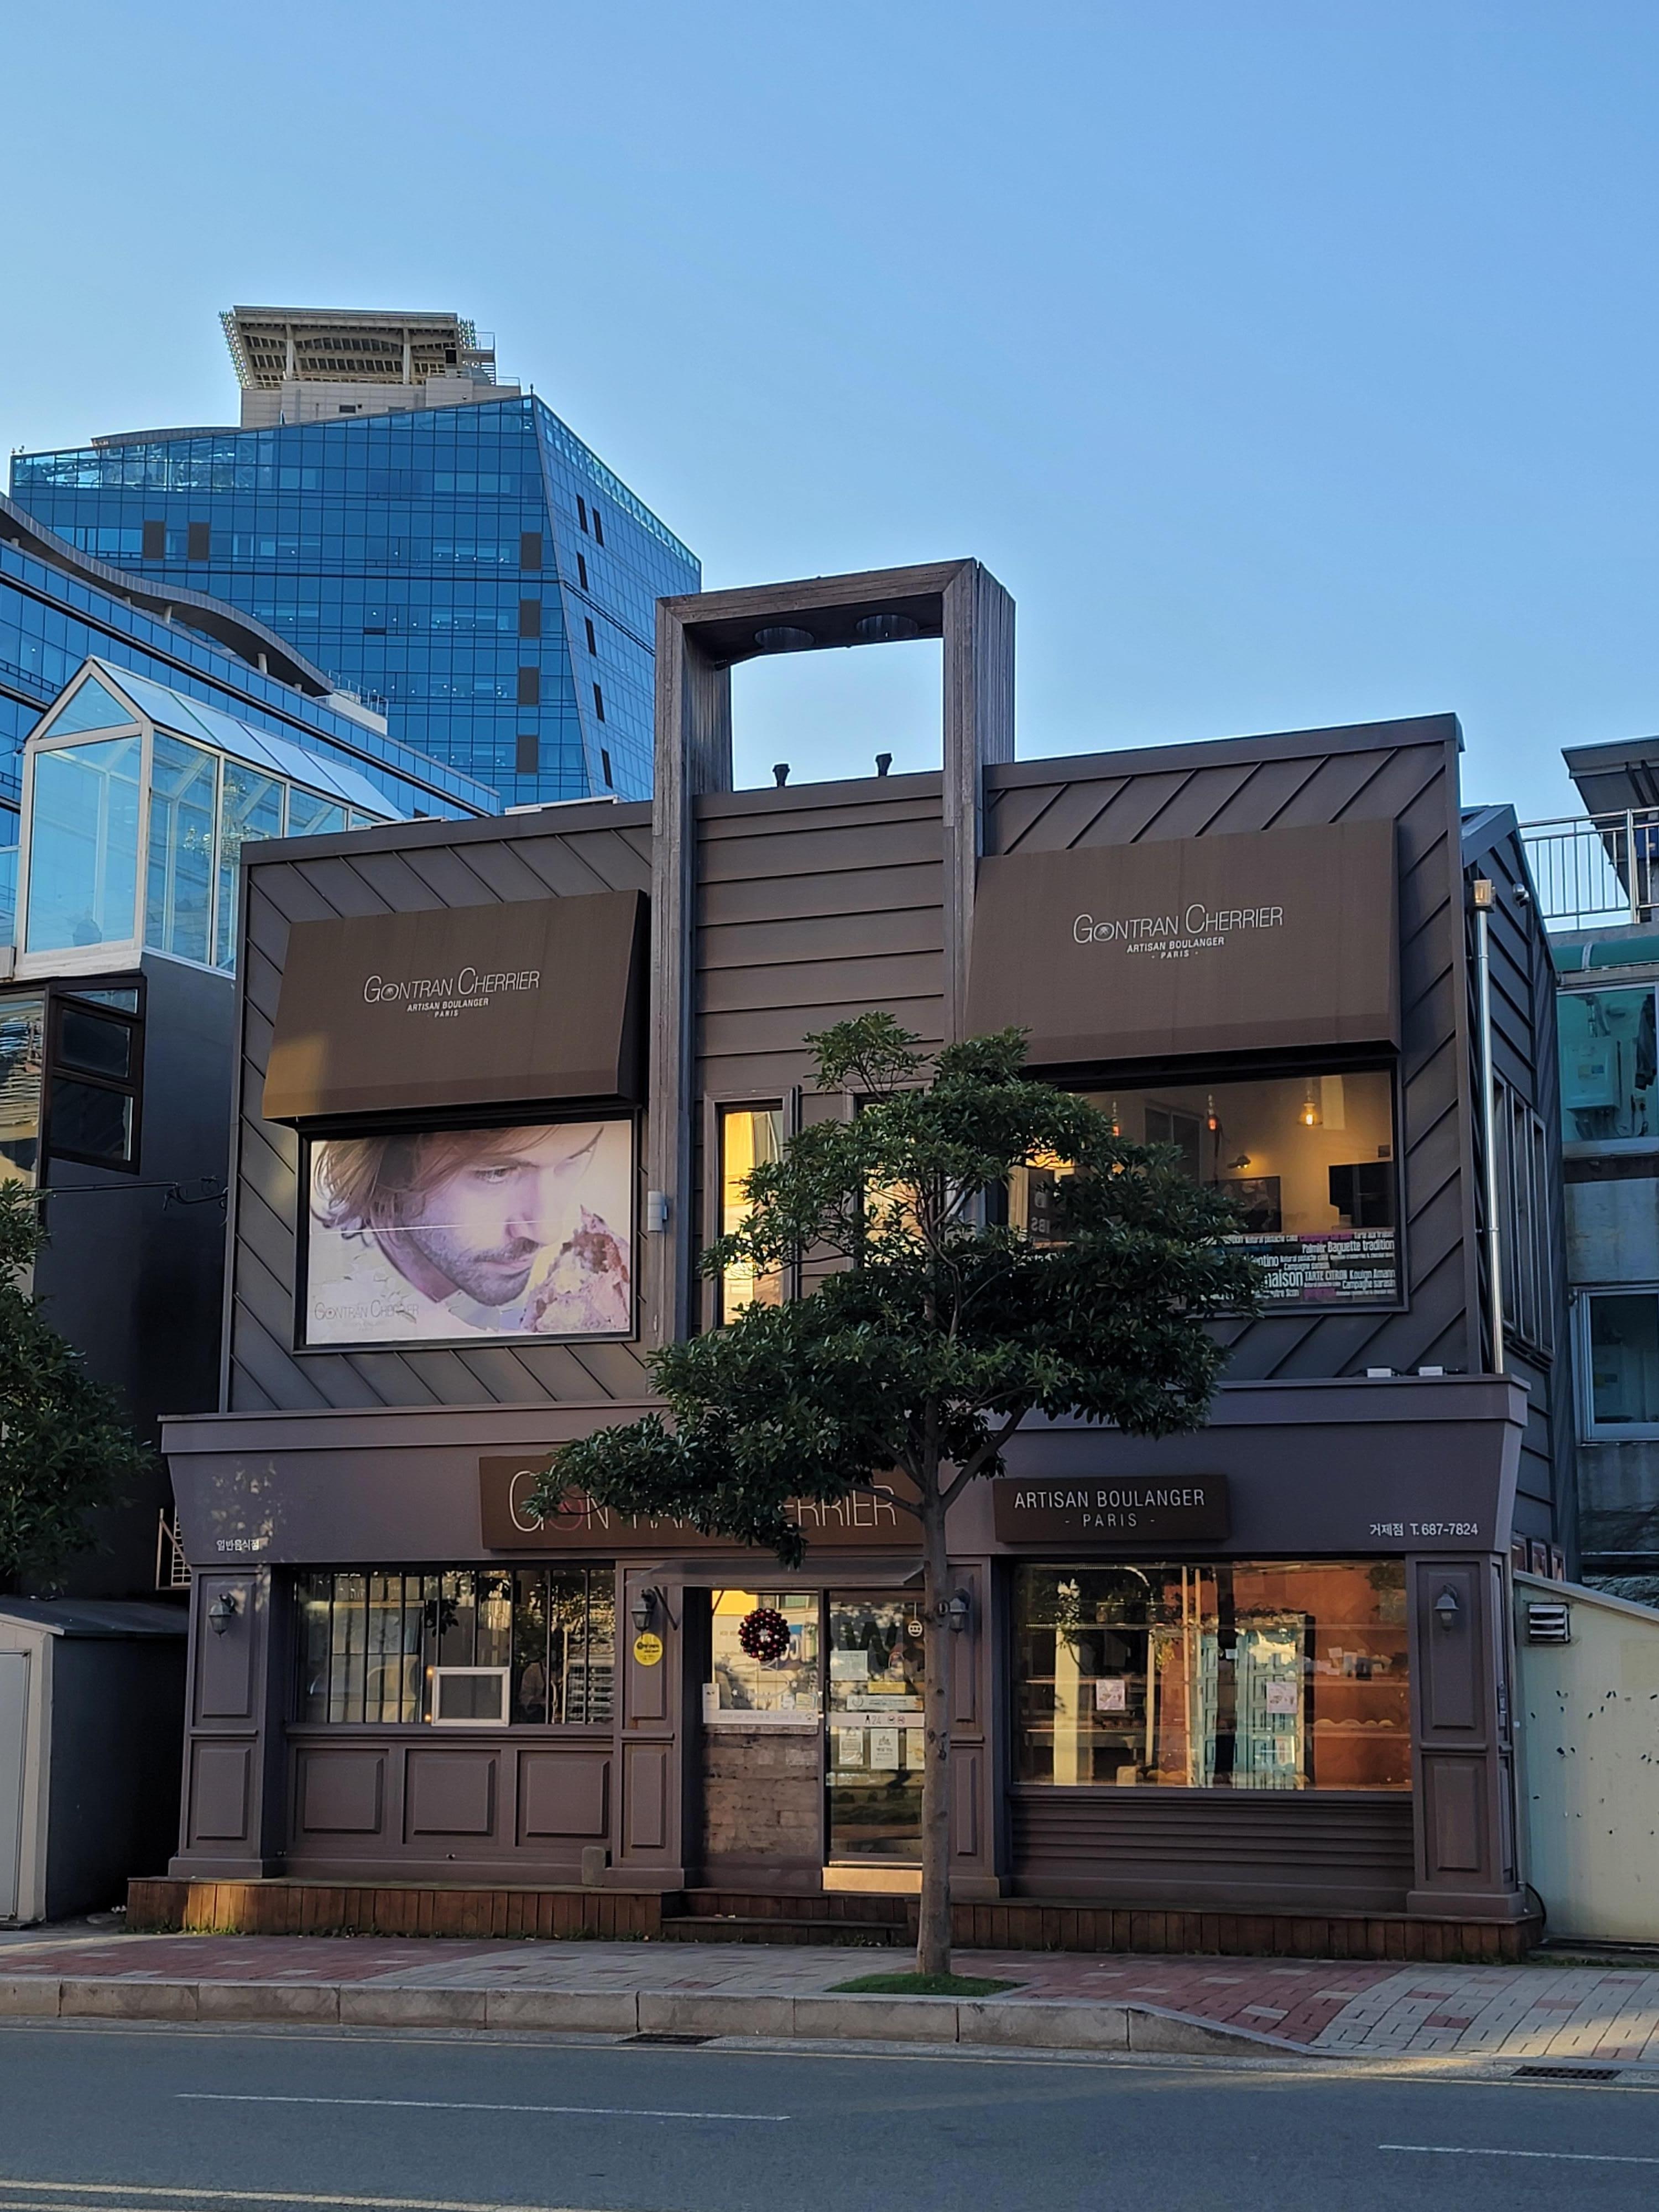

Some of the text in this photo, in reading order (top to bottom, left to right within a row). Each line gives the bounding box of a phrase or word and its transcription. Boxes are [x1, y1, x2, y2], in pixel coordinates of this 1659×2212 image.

[1073, 904, 1283, 944] GONTRAN CHERRIER
[1126, 936, 1225, 953] ARTISAN BOULANGER
[1160, 950, 1190, 959] PARIS
[364, 967, 540, 1003] GONTRAN CHERRIER
[406, 998, 489, 1012] ARTISAN BOULANGER
[1327, 1240, 1361, 1255] Baguette
[1363, 1239, 1395, 1251] tradition
[1342, 1280, 1372, 1290] Campagne
[1014, 1489, 1205, 1509] ARTISAN BOULANGER
[1083, 1513, 1138, 1527] PARIS
[1369, 1523, 1404, 1537] 거제점
[216, 1539, 260, 1552] 일반음식점
